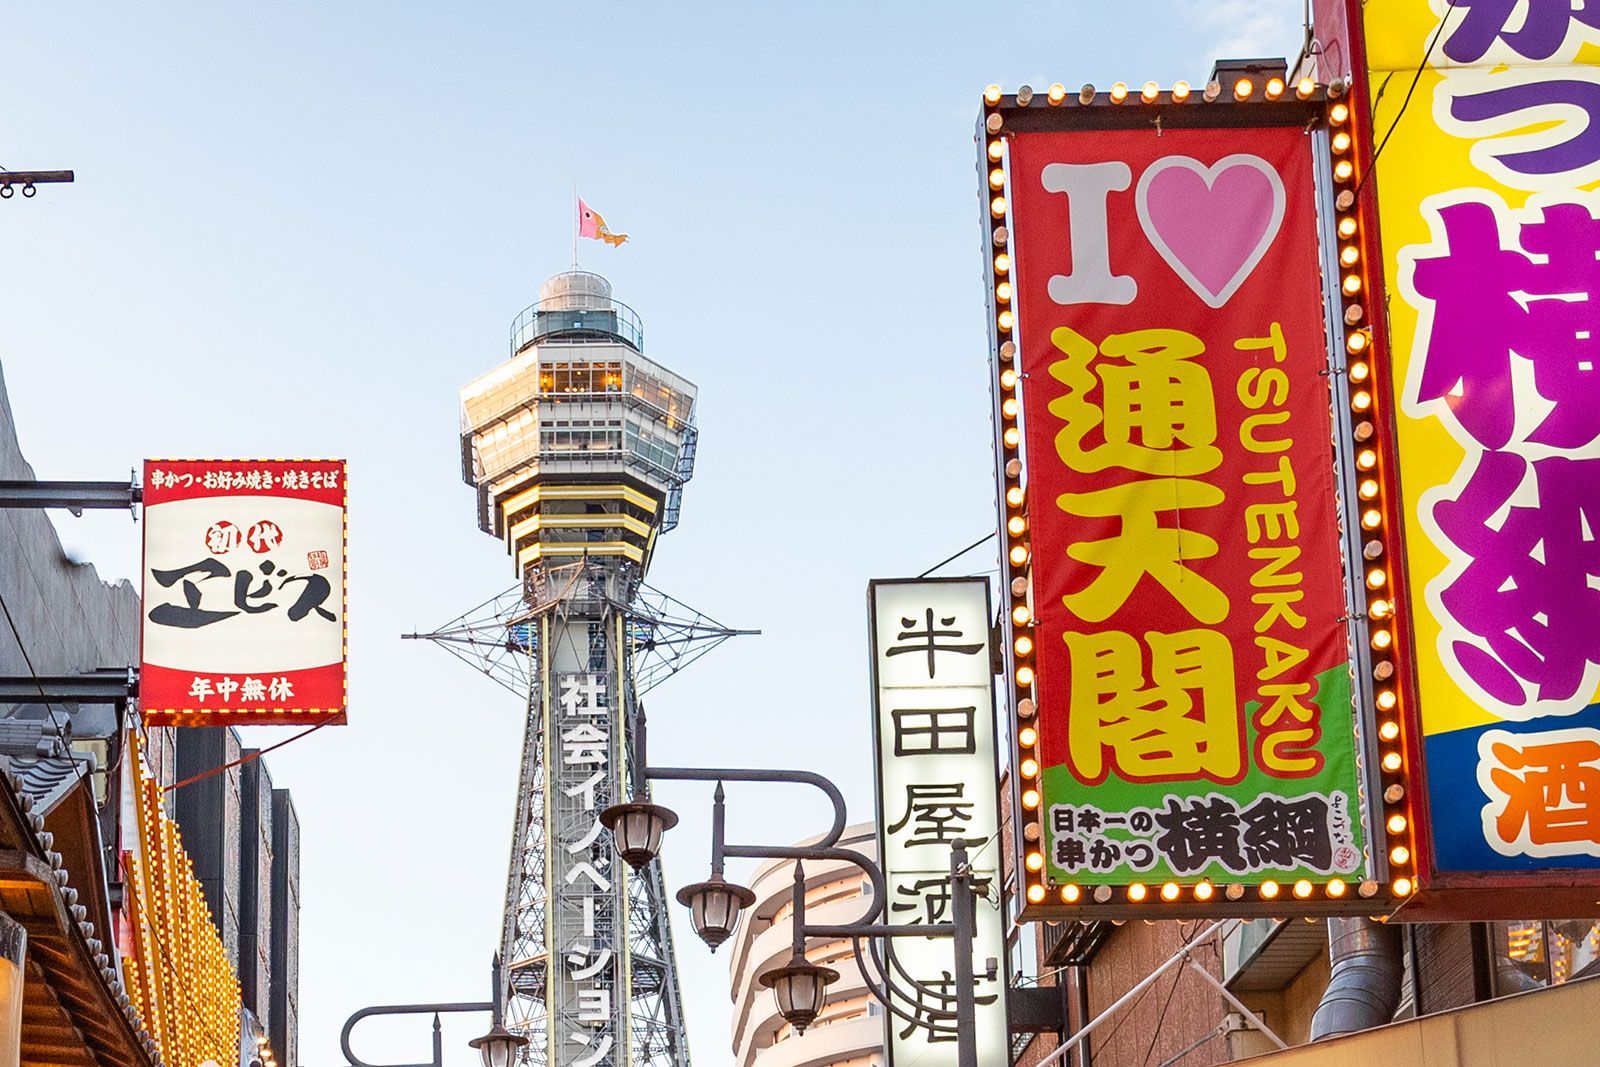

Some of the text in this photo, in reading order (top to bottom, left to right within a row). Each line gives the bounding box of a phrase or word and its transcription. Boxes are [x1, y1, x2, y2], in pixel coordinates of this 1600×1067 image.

[1041, 161, 1138, 305] I
[151, 469, 339, 490] 串かつ・お好み焼き・焼きそば
[205, 520, 283, 554] 初代
[1048, 326, 1241, 779] 通天閣
[1233, 322, 1317, 773] TSUTENKAKU
[148, 557, 337, 628] エビス
[188, 677, 295, 702] 年中無休
[1054, 808, 1153, 832] 日本一の
[1057, 837, 1155, 869] 串かつ
[1154, 797, 1332, 872] 横綱
[560, 675, 613, 1067] 社会イノベーション
